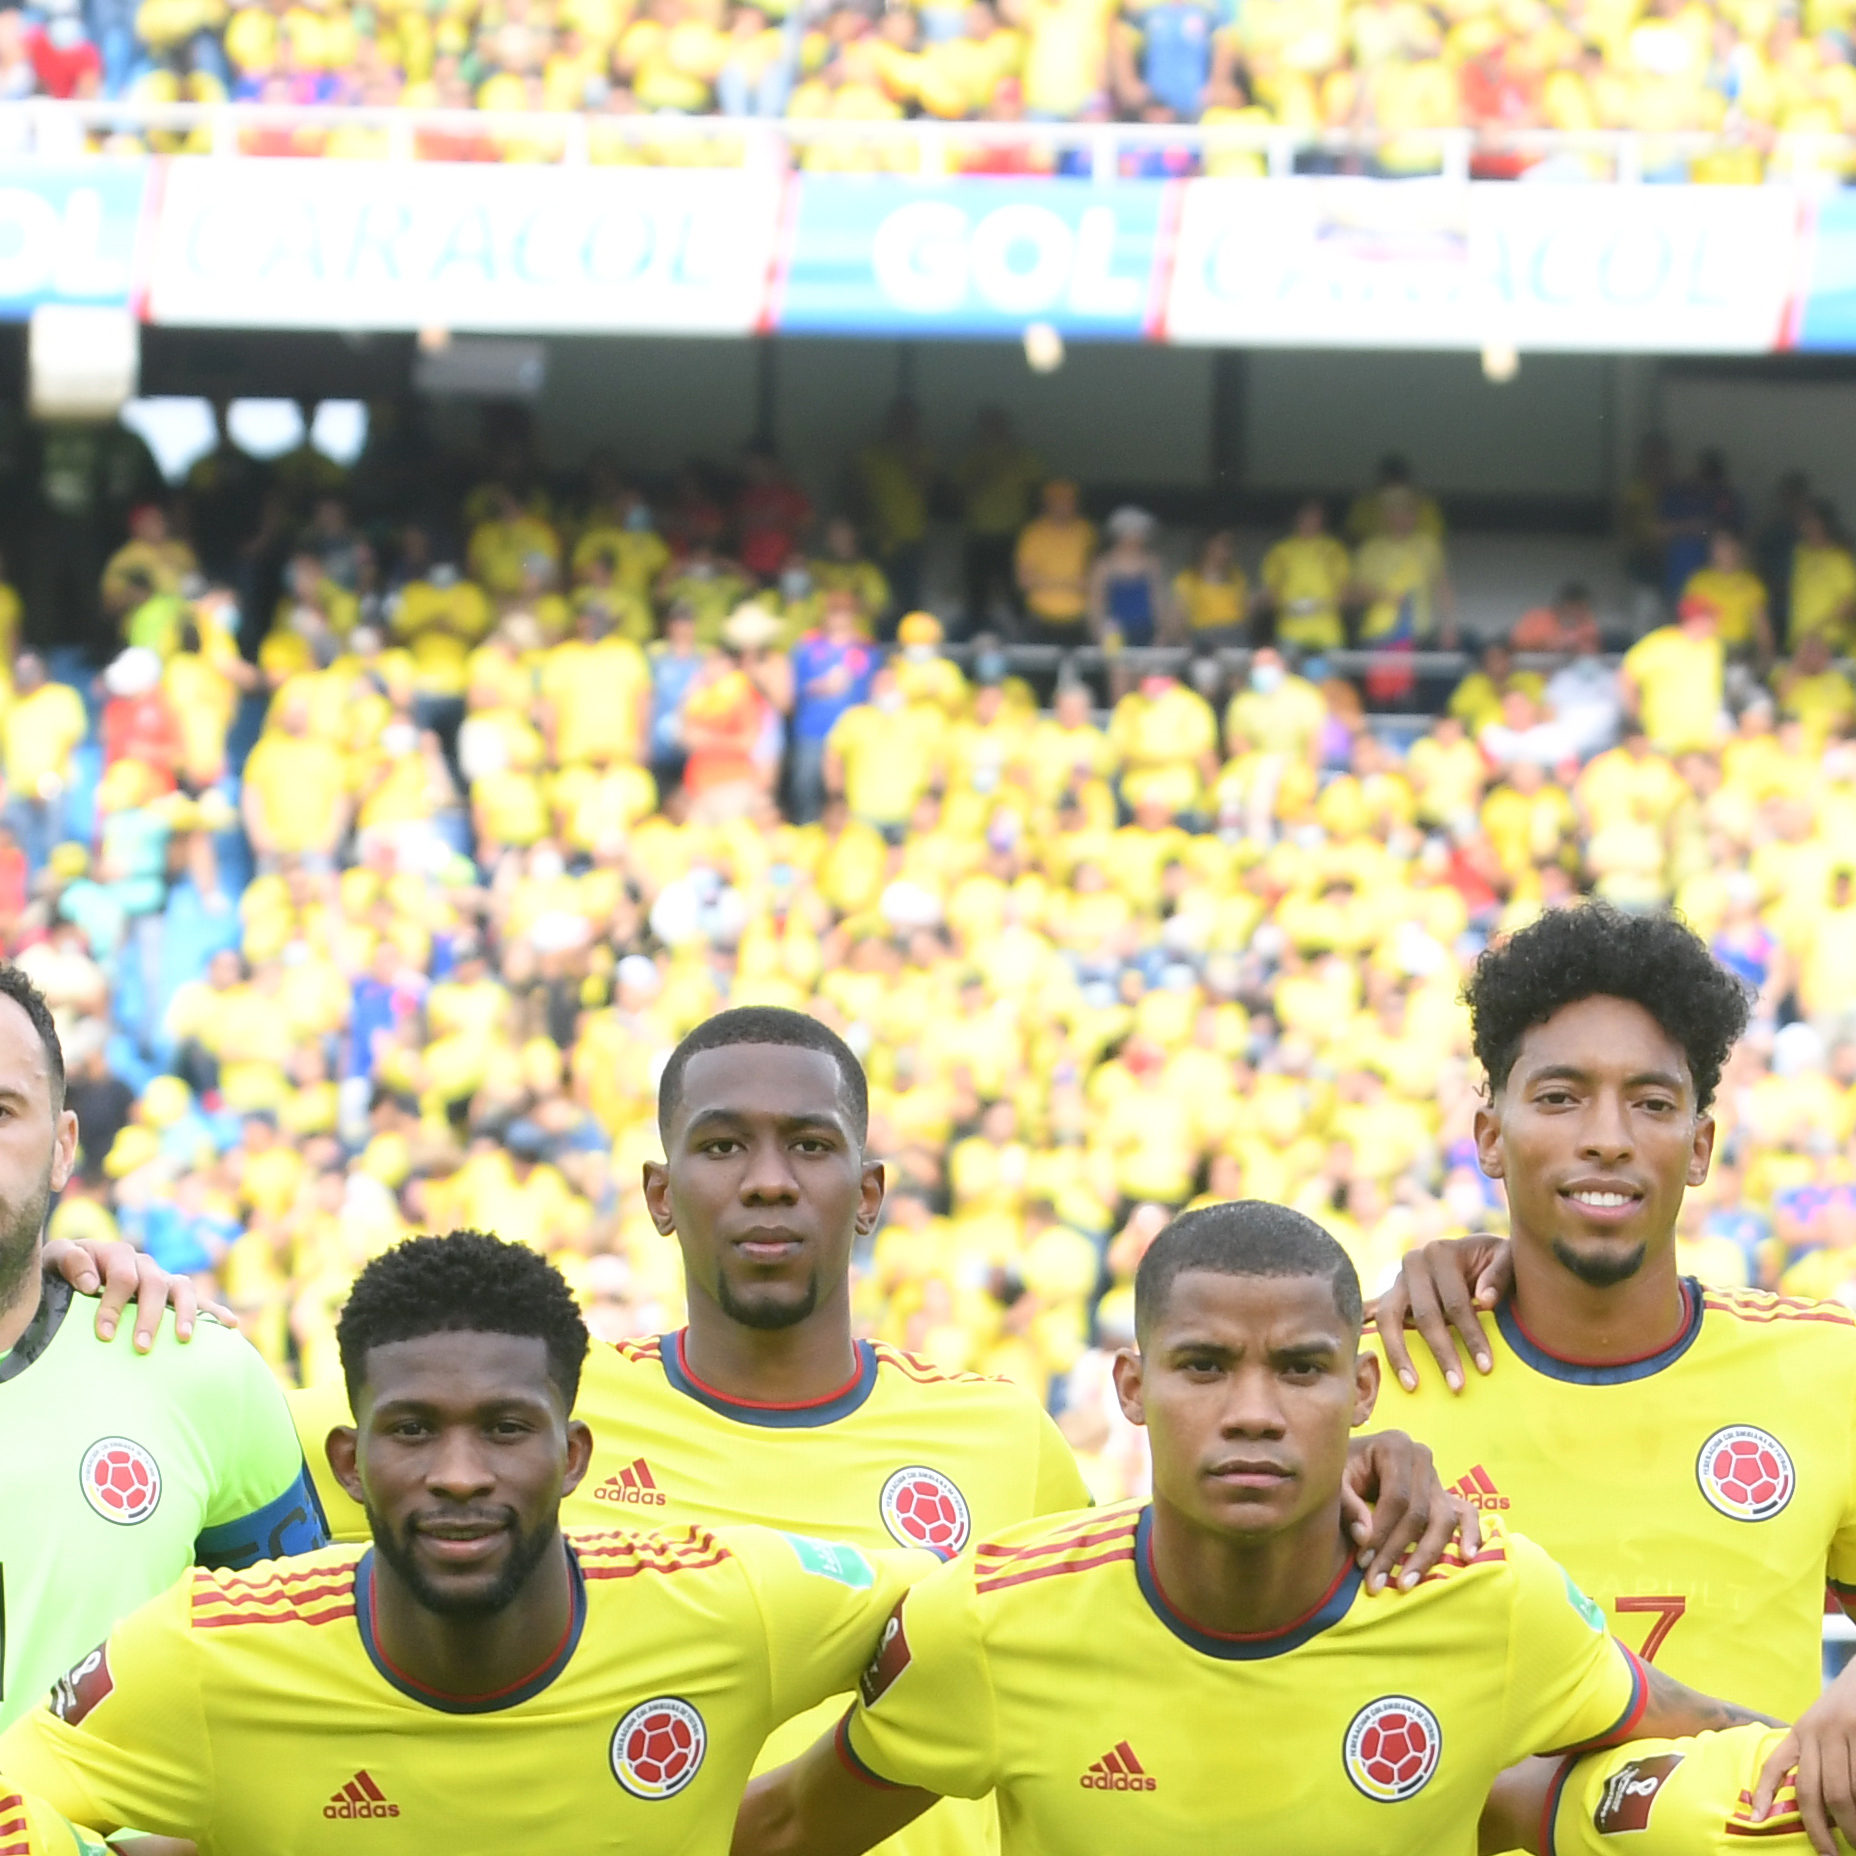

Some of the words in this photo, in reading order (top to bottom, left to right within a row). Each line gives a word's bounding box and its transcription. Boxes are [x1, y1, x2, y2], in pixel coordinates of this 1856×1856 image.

[182, 198, 716, 290] CARACOL
[870, 200, 1142, 314] GOL
[594, 1483, 666, 1506] adidas
[1614, 1594, 1686, 1664] 7
[1080, 1773, 1157, 1793] adidas
[323, 1799, 400, 1820] adidas
